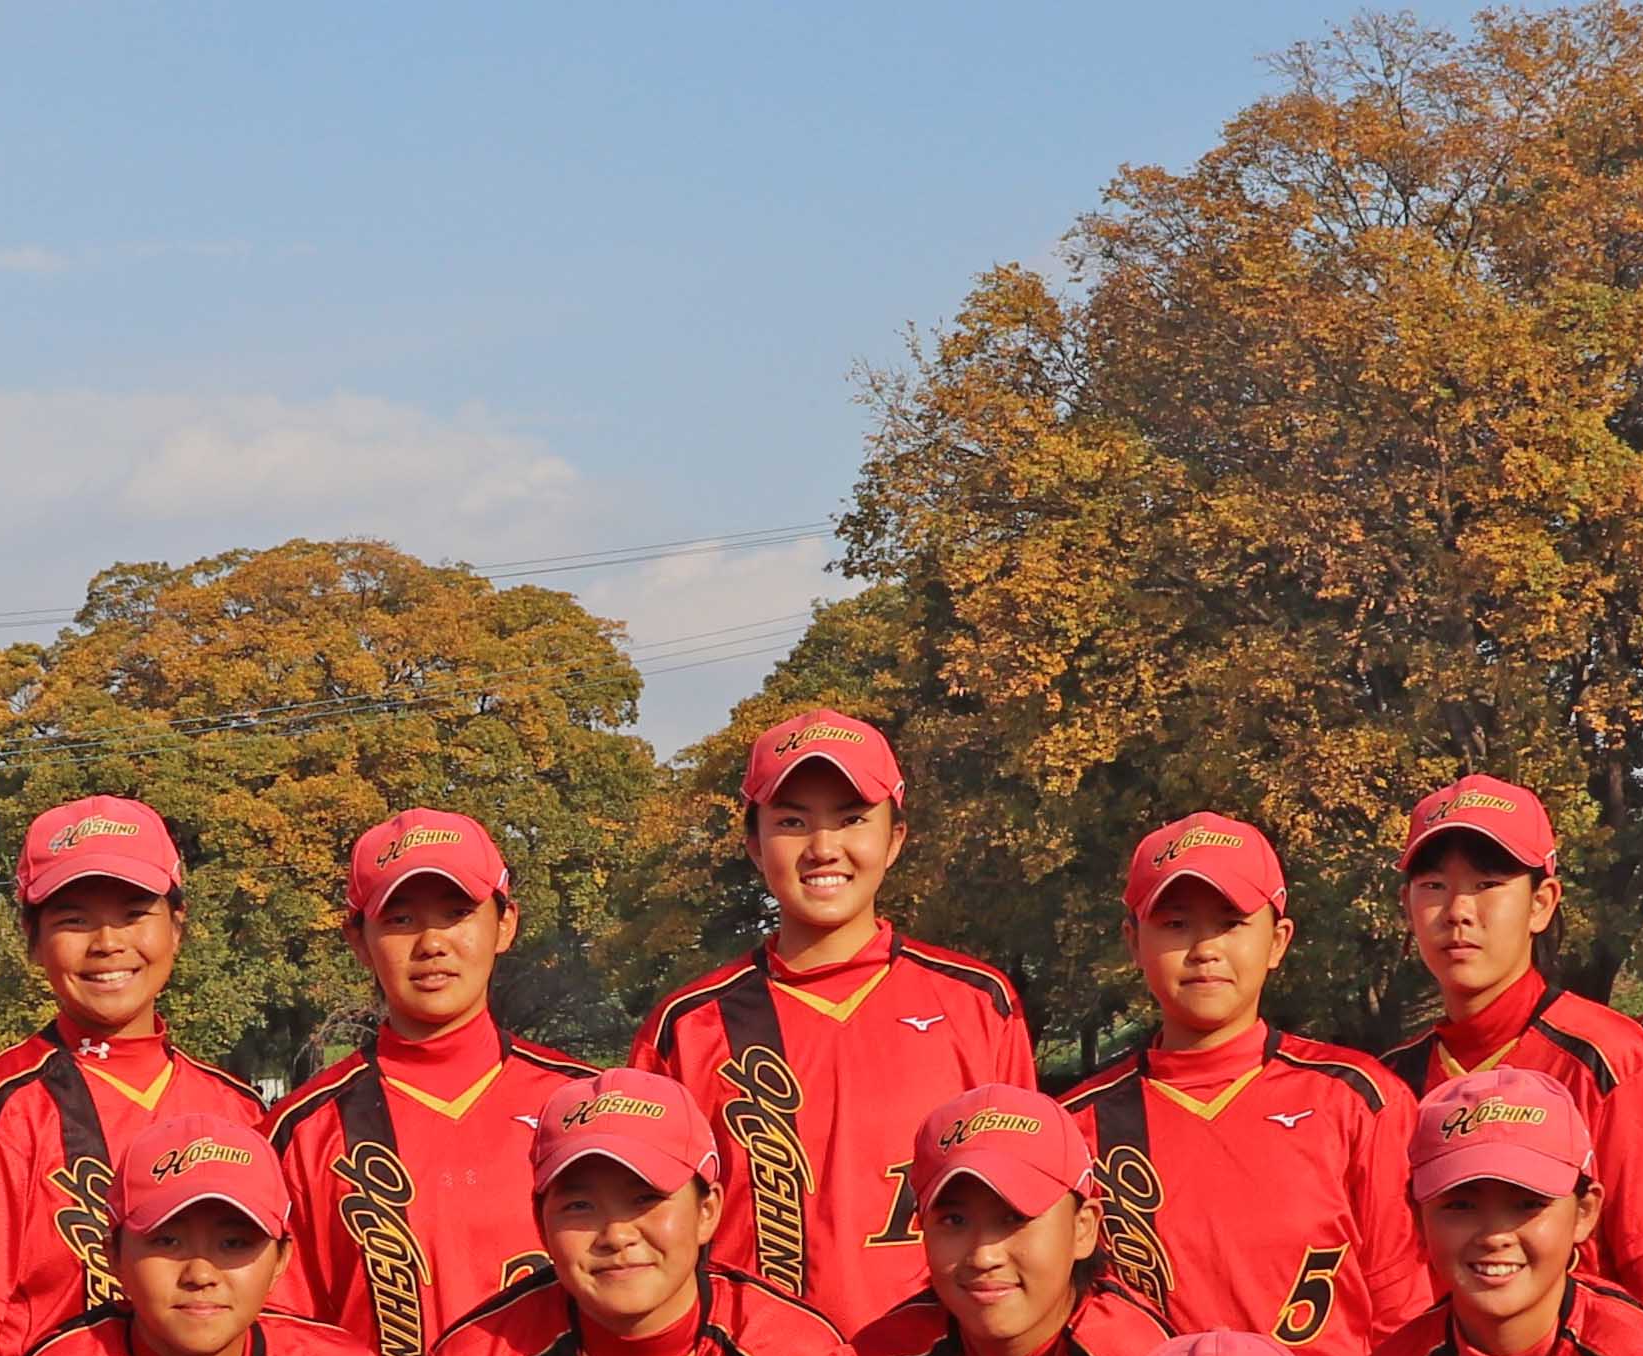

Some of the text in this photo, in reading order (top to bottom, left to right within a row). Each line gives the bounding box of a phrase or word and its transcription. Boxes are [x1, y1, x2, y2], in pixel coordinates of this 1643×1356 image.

[774, 721, 865, 758] HOSHINO
[1424, 789, 1516, 827] HOSHINO
[48, 814, 140, 855] HOSHINO
[376, 825, 462, 870] HOSHINO
[1153, 826, 1244, 871] HOSHINO
[563, 1089, 666, 1131] HOSHINO
[939, 1106, 1042, 1154] HOSHINO
[1440, 1095, 1548, 1144] HOSHINO
[151, 1137, 252, 1184] HOSHINO
[1274, 1241, 1351, 1345] 5
